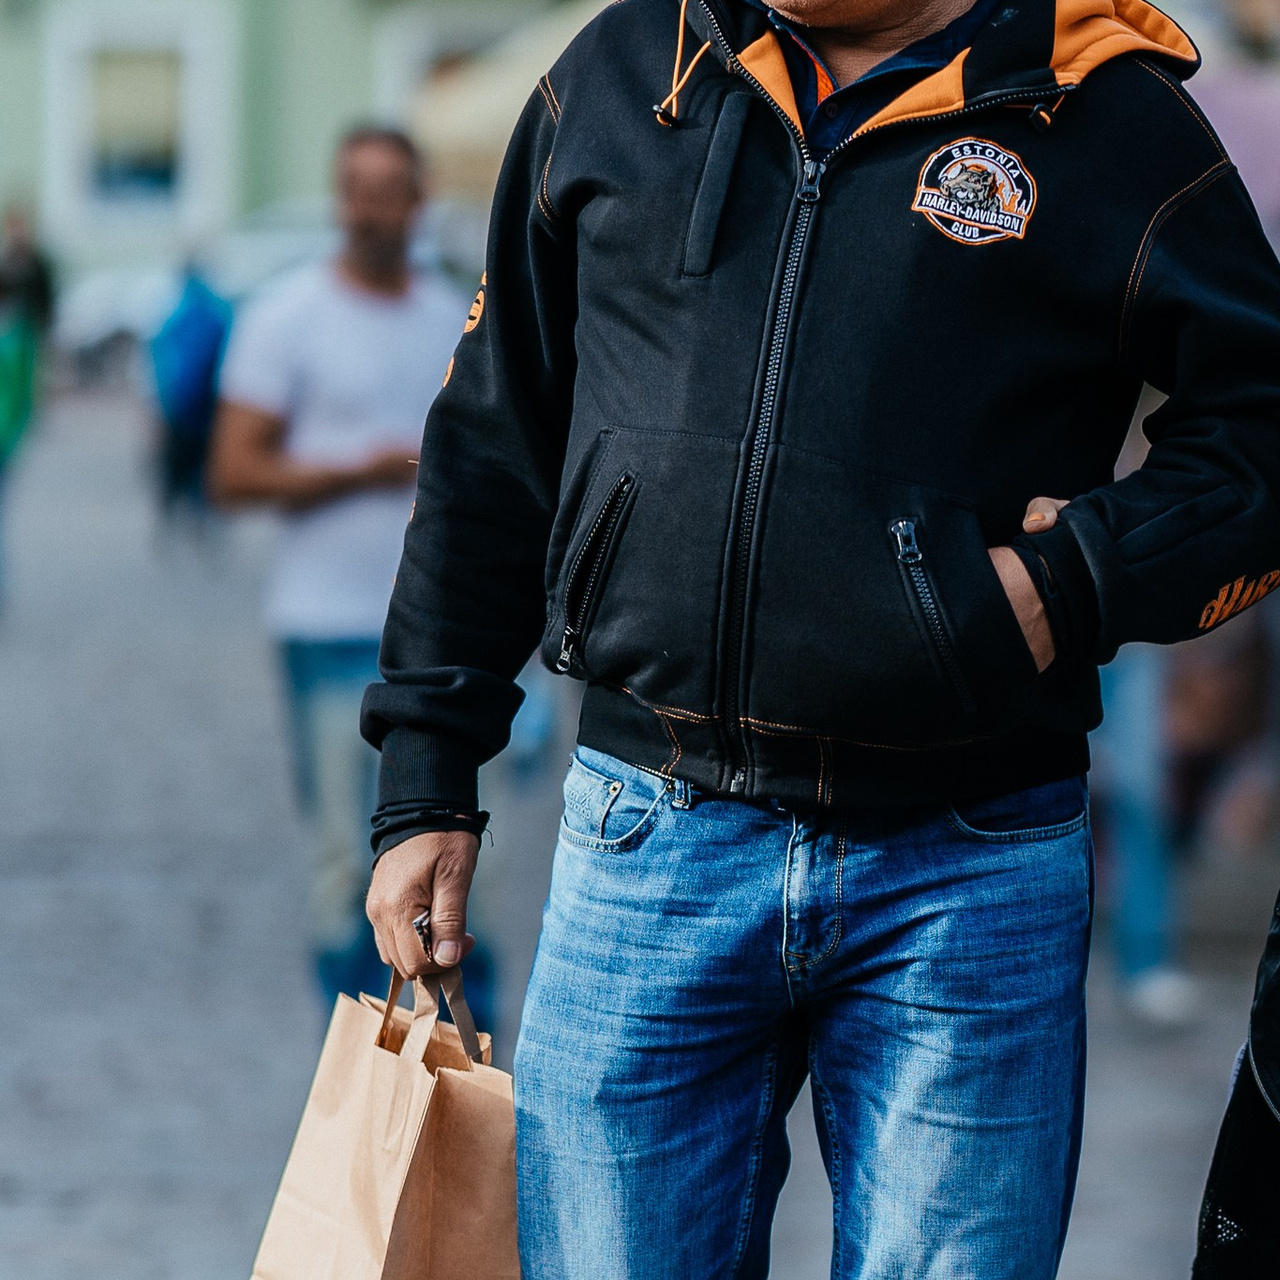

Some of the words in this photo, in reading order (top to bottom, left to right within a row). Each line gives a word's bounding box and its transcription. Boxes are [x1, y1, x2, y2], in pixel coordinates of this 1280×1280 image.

[951, 145, 1022, 179] ESTONIA
[922, 193, 1020, 231] HARLEY-DAVIDSON
[951, 222, 980, 238] CLUB
